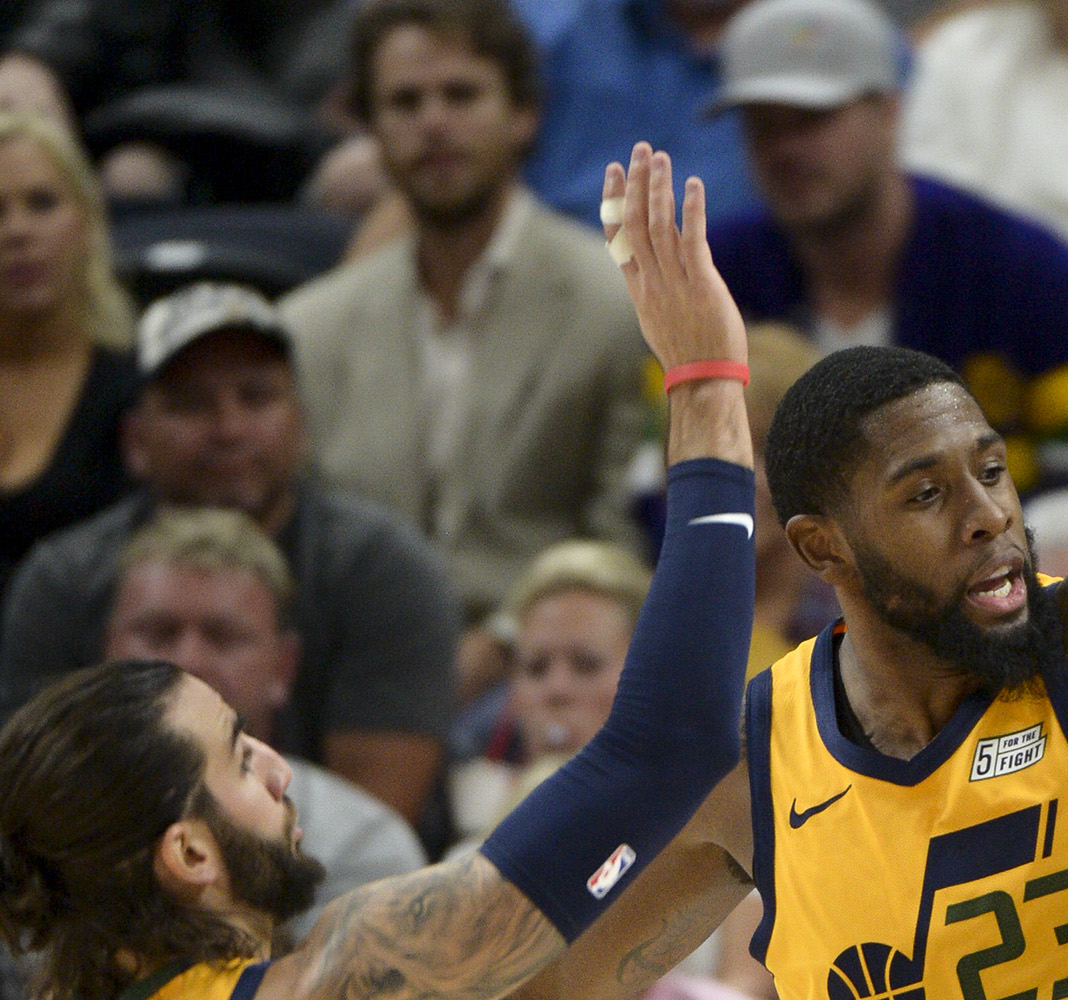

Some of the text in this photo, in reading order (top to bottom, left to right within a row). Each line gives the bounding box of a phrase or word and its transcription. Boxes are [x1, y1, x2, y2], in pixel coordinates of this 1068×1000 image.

[1003, 730, 1037, 749] FOR THE
[977, 744, 993, 775] 5
[1000, 743, 1042, 771] FIGHT
